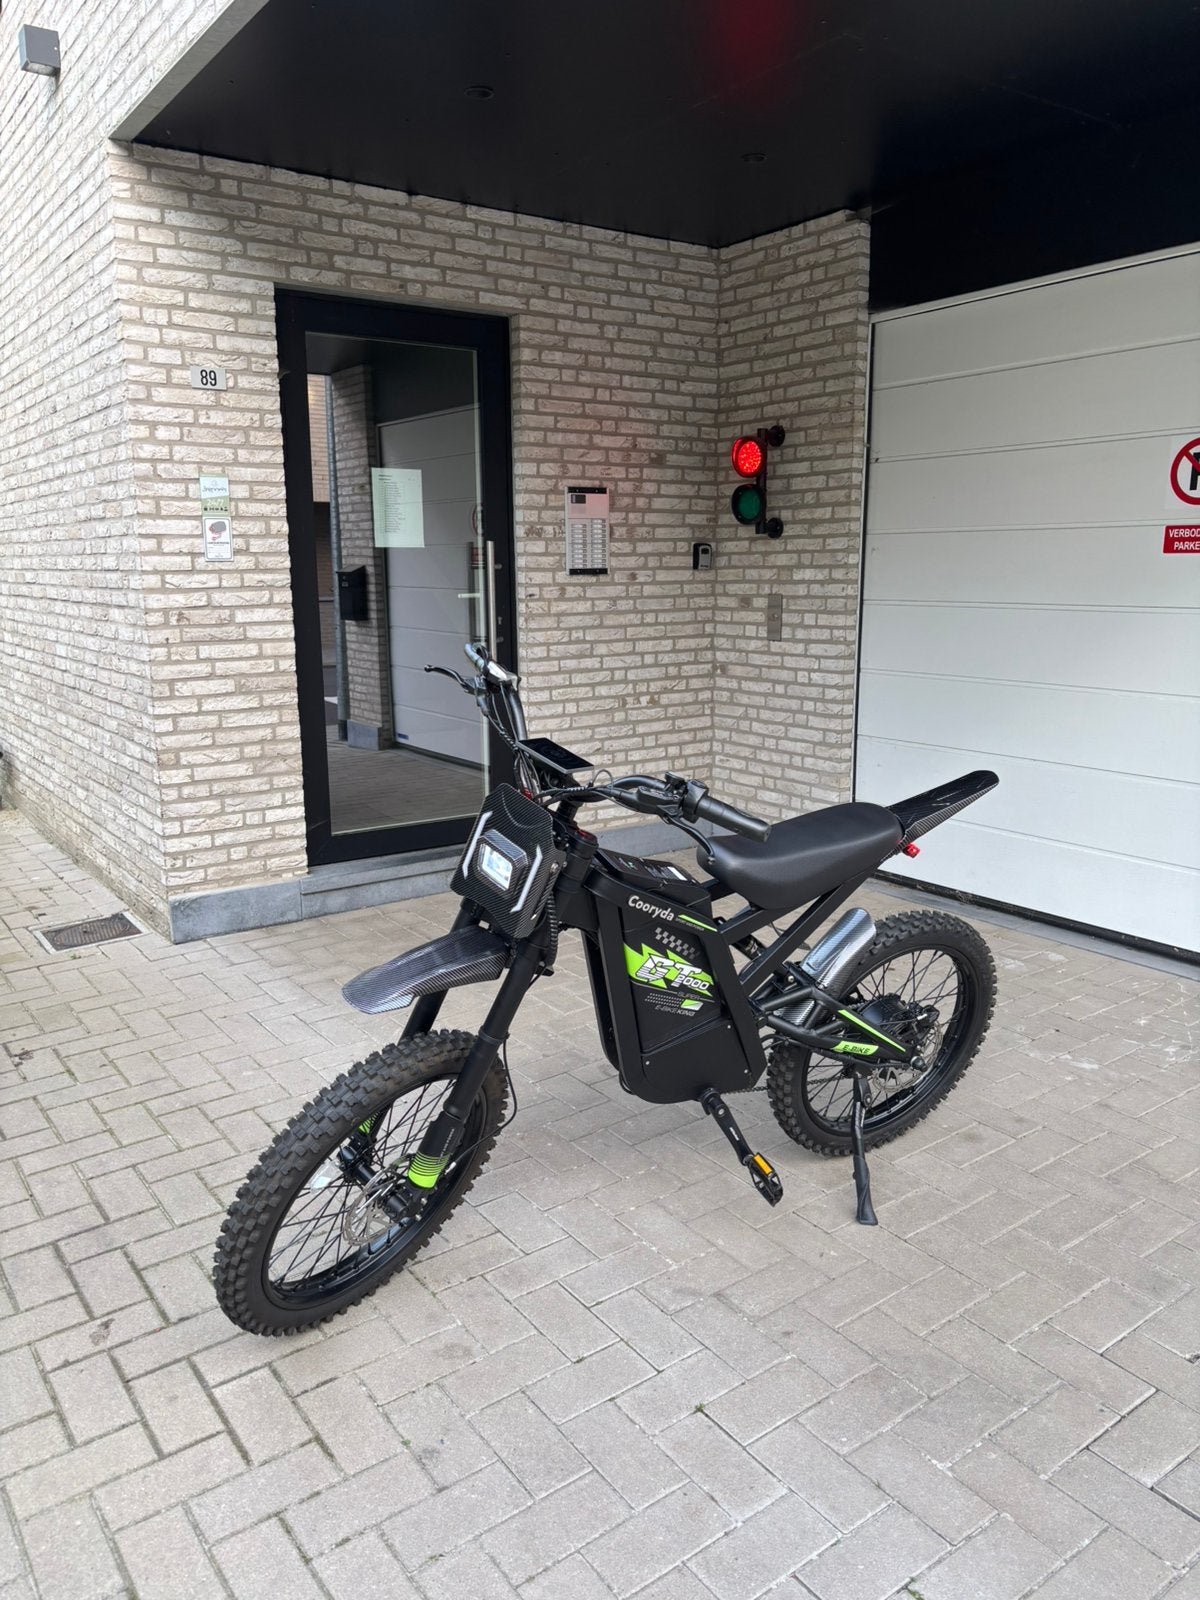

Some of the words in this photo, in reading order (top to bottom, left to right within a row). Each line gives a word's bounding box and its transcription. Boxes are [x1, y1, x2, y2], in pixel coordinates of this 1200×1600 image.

[200, 369, 217, 386] 89
[1173, 541, 1200, 551] PARKE
[628, 895, 675, 921] Cooryda
[635, 954, 703, 982] GT
[670, 974, 710, 990] 2000
